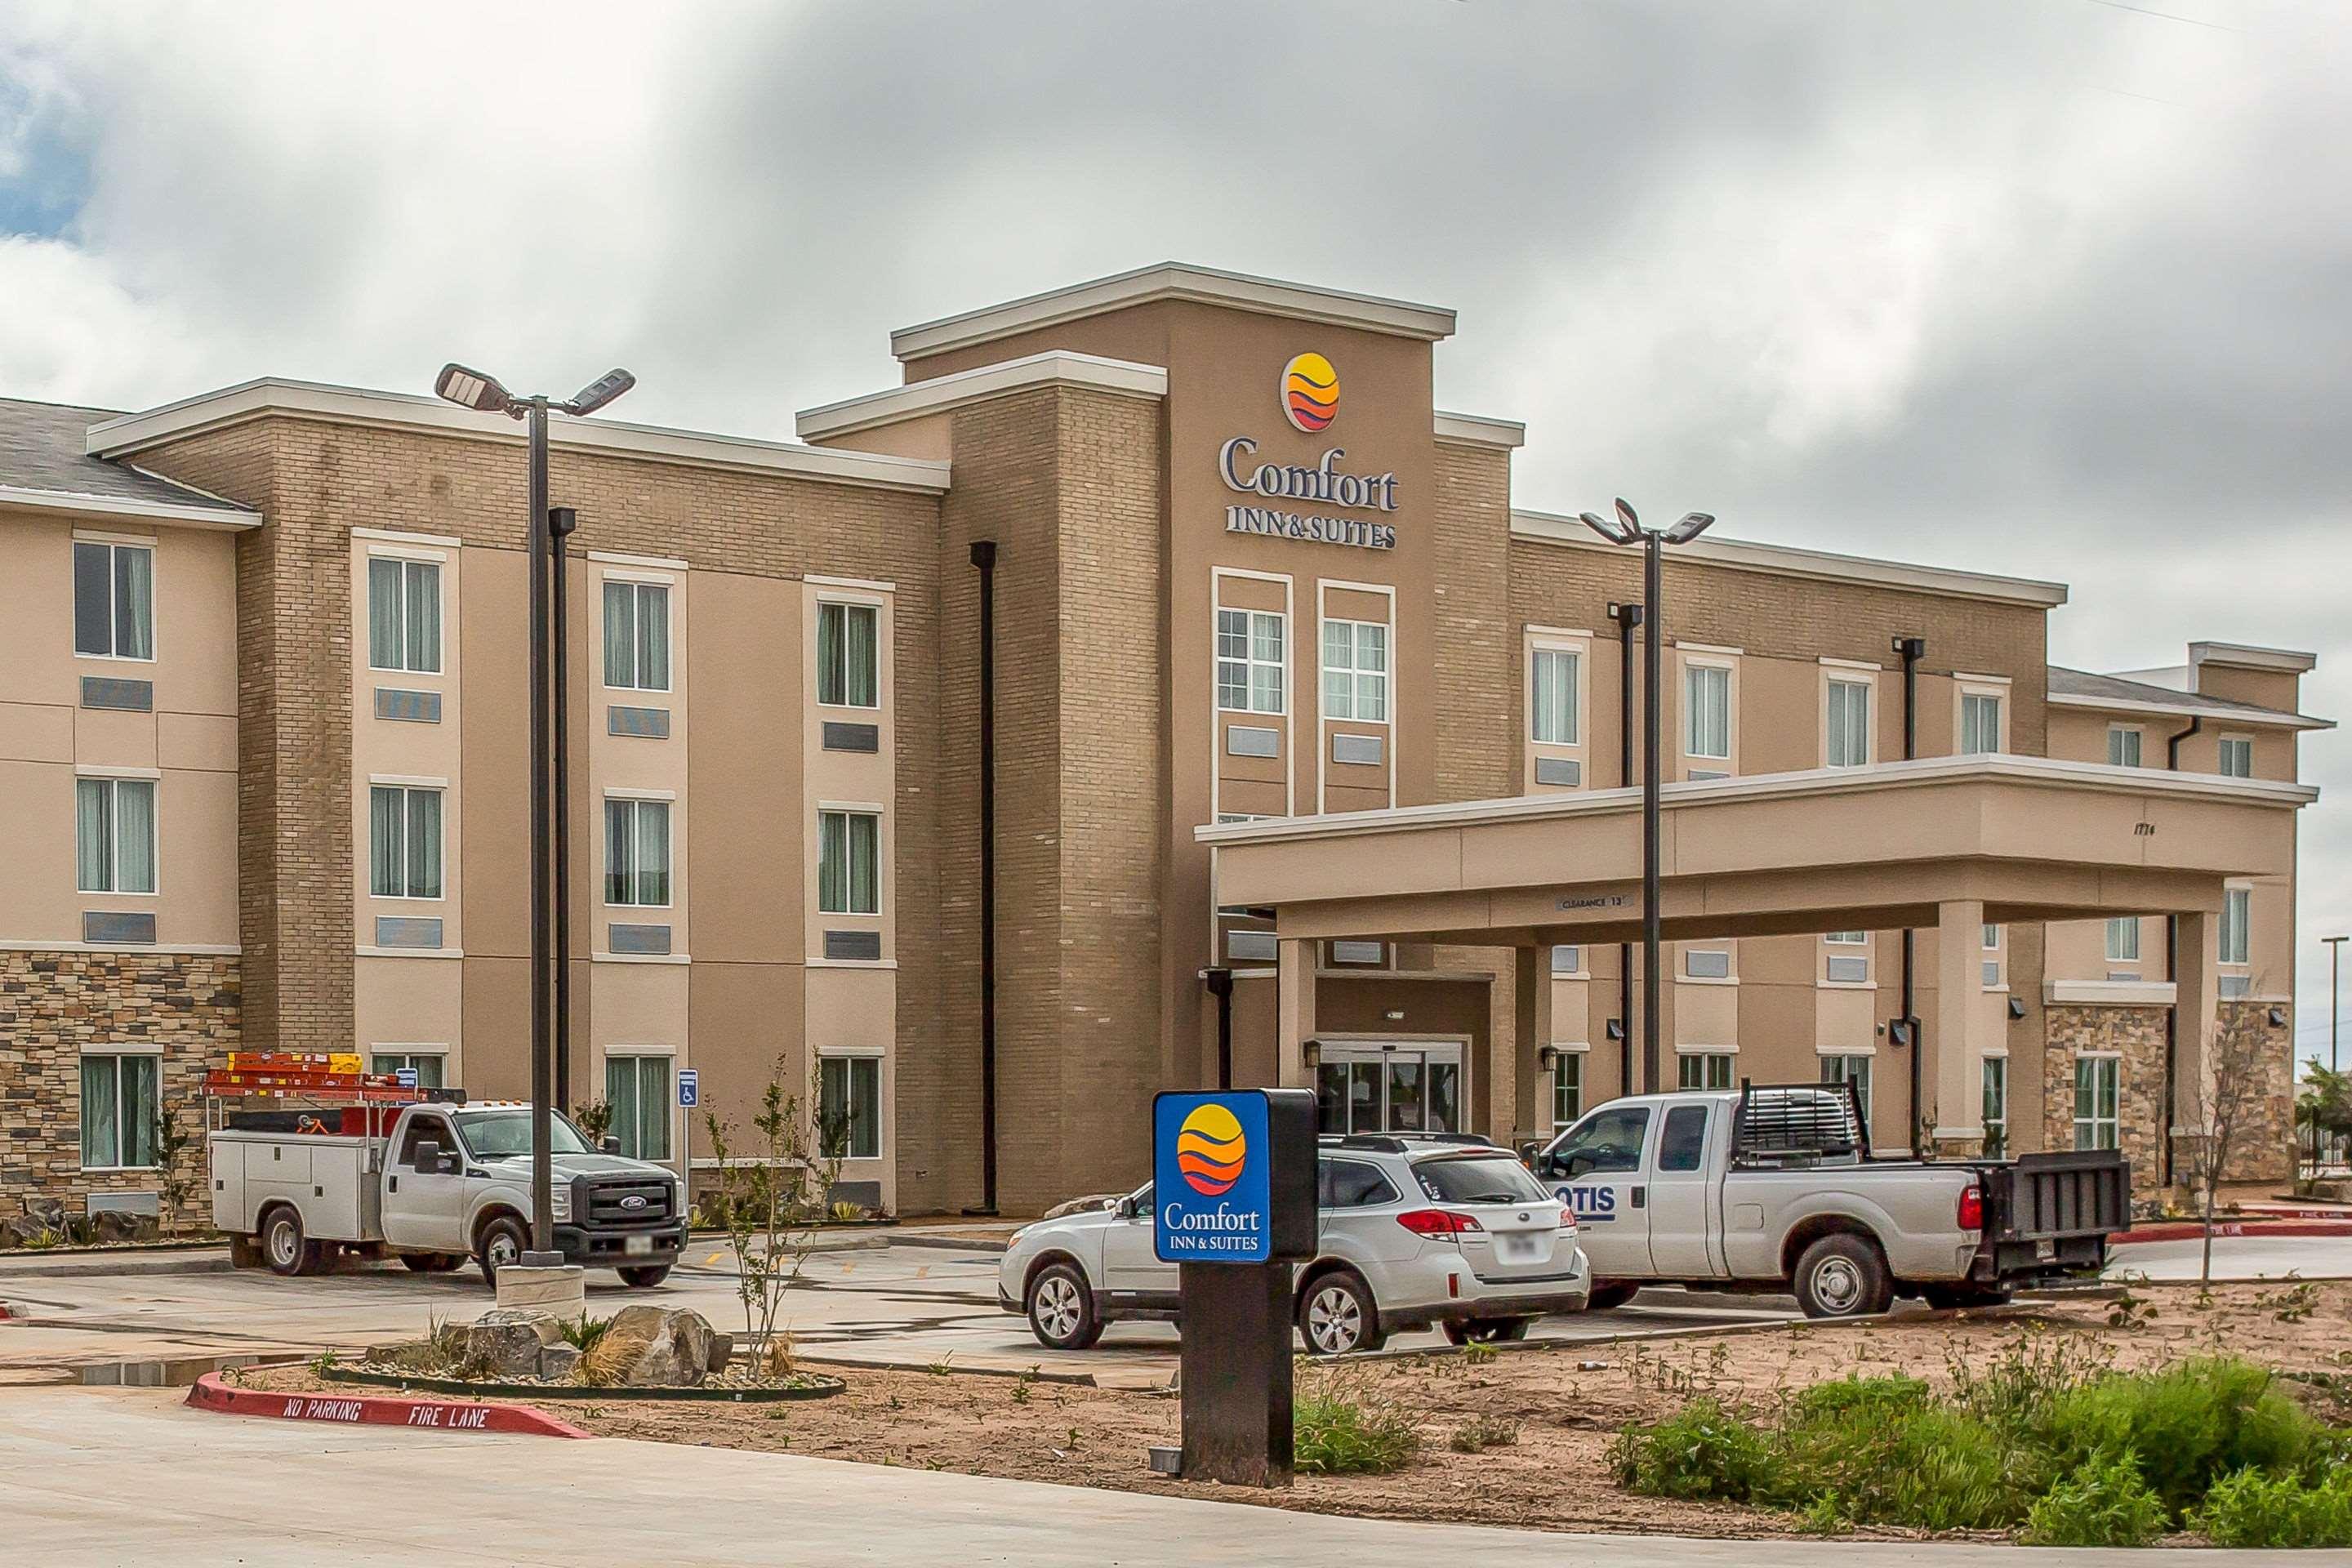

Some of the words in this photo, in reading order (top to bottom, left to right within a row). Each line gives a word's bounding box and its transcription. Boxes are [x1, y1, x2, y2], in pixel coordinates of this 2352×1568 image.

[1219, 436, 1399, 511] Comfort
[1561, 898, 1606, 909] CLEARANCE
[1553, 1186, 1615, 1212] OTIS
[1164, 1201, 1260, 1232] Comfort
[1169, 1236, 1196, 1250] INN
[1198, 1237, 1208, 1250] &
[1209, 1236, 1258, 1251] SUITES
[283, 1398, 304, 1418] NO
[305, 1399, 363, 1422] PARKING
[408, 1405, 443, 1427] FIRE
[448, 1407, 491, 1428] LANE
